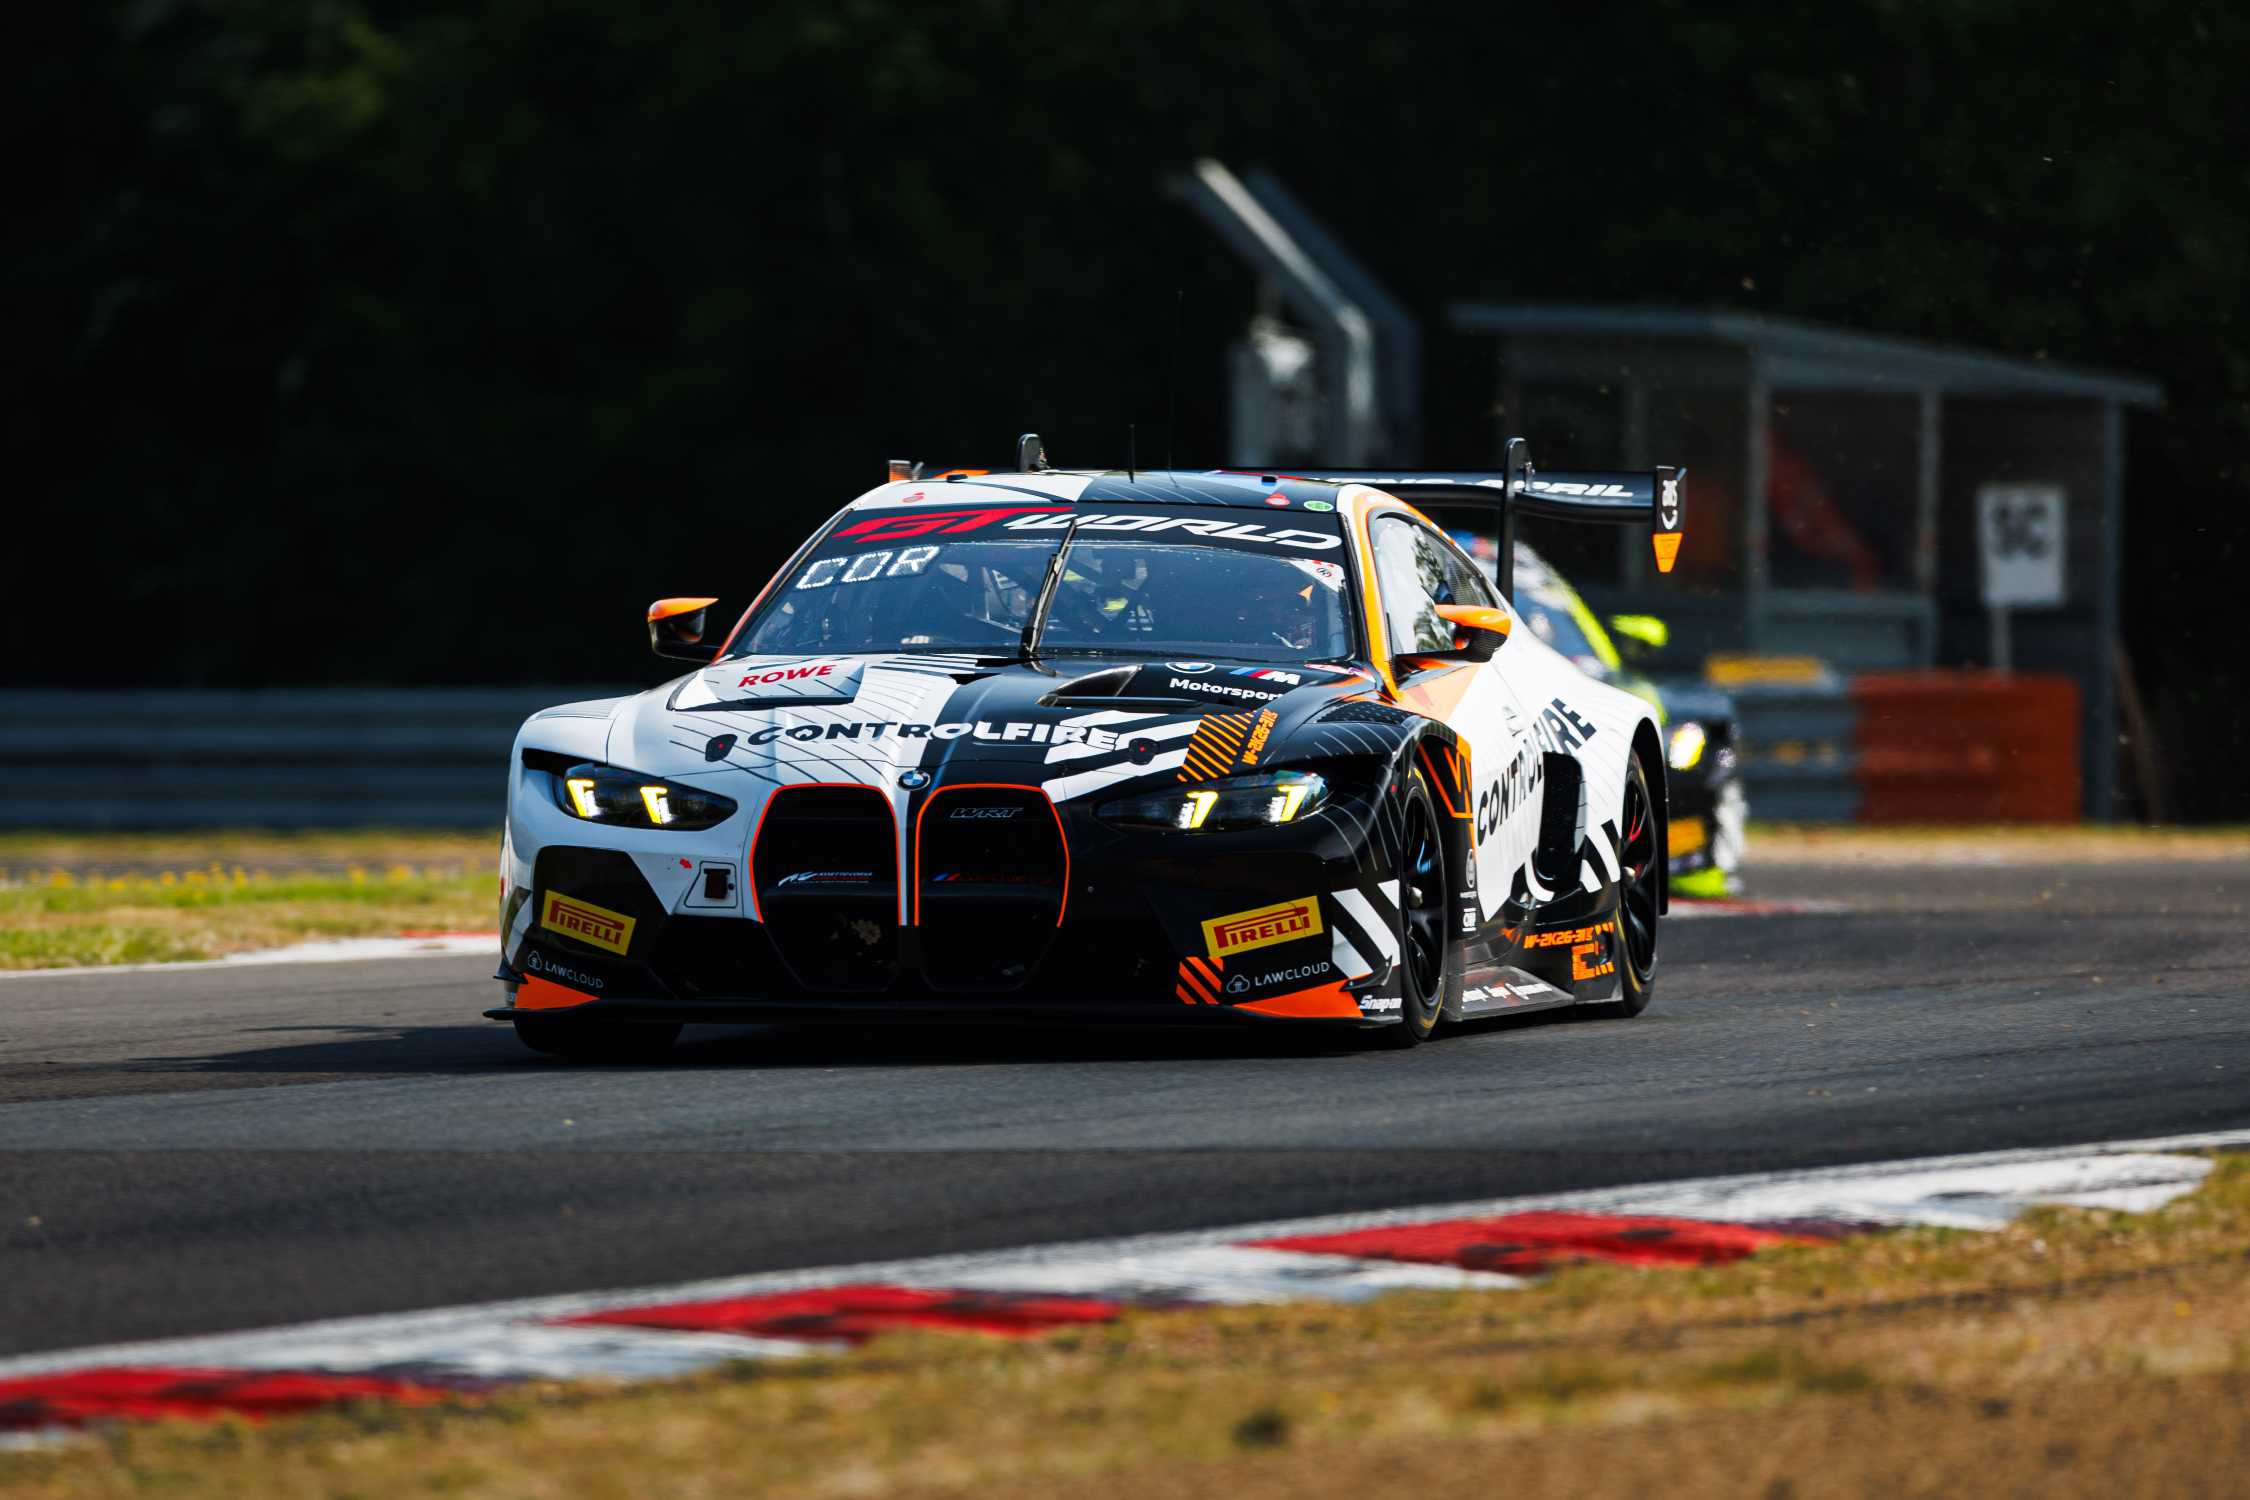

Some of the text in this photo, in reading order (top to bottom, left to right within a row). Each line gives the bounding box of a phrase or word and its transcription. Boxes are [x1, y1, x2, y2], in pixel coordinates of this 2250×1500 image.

[831, 505, 1343, 550] GT WORLD
[795, 545, 940, 590] COR
[738, 664, 836, 688] ROWE
[747, 719, 1120, 751] CONTROLFIRE
[950, 807, 1024, 818] WRT
[548, 899, 625, 945] PIRELLI
[1213, 906, 1310, 949] PIRELLI
[545, 960, 604, 989] LAWCLOUD
[1254, 961, 1330, 987] LAWCLOUD
